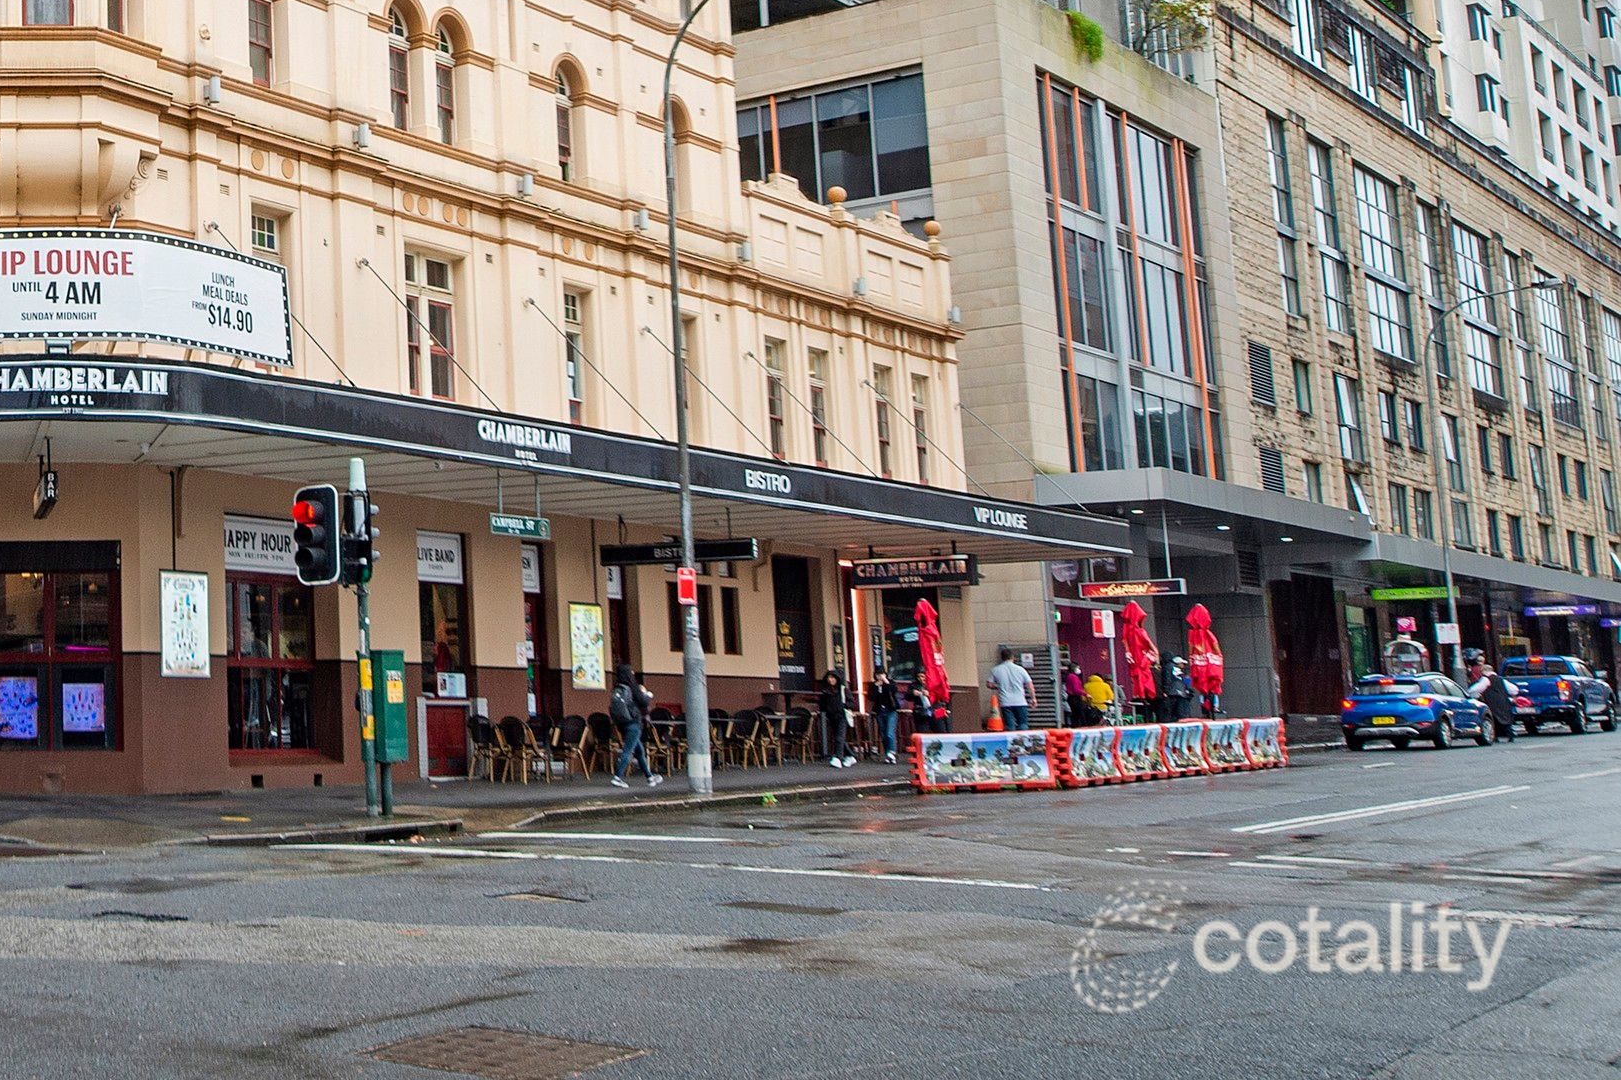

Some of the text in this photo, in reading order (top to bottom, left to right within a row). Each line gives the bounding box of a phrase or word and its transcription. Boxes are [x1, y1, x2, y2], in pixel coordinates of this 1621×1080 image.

[34, 249, 134, 276] LOUNGE
[211, 272, 235, 288] LUNCH
[12, 281, 102, 305] UNTIL 4 AM
[202, 284, 249, 307] MEAL DEALS
[20, 311, 98, 321] SUNDAY MIDNIGHT
[191, 300, 253, 334] FROM $14.90
[50, 395, 95, 405] HOTEL
[477, 419, 572, 454] CHAMBERLAIN
[47, 472, 55, 498] BAR
[744, 469, 792, 494] BISTRO
[990, 508, 1029, 530] LOUNGE
[261, 532, 292, 553] HOUR
[417, 547, 456, 564] LIVE BAND
[856, 560, 968, 578] CHAMBERLAIN
